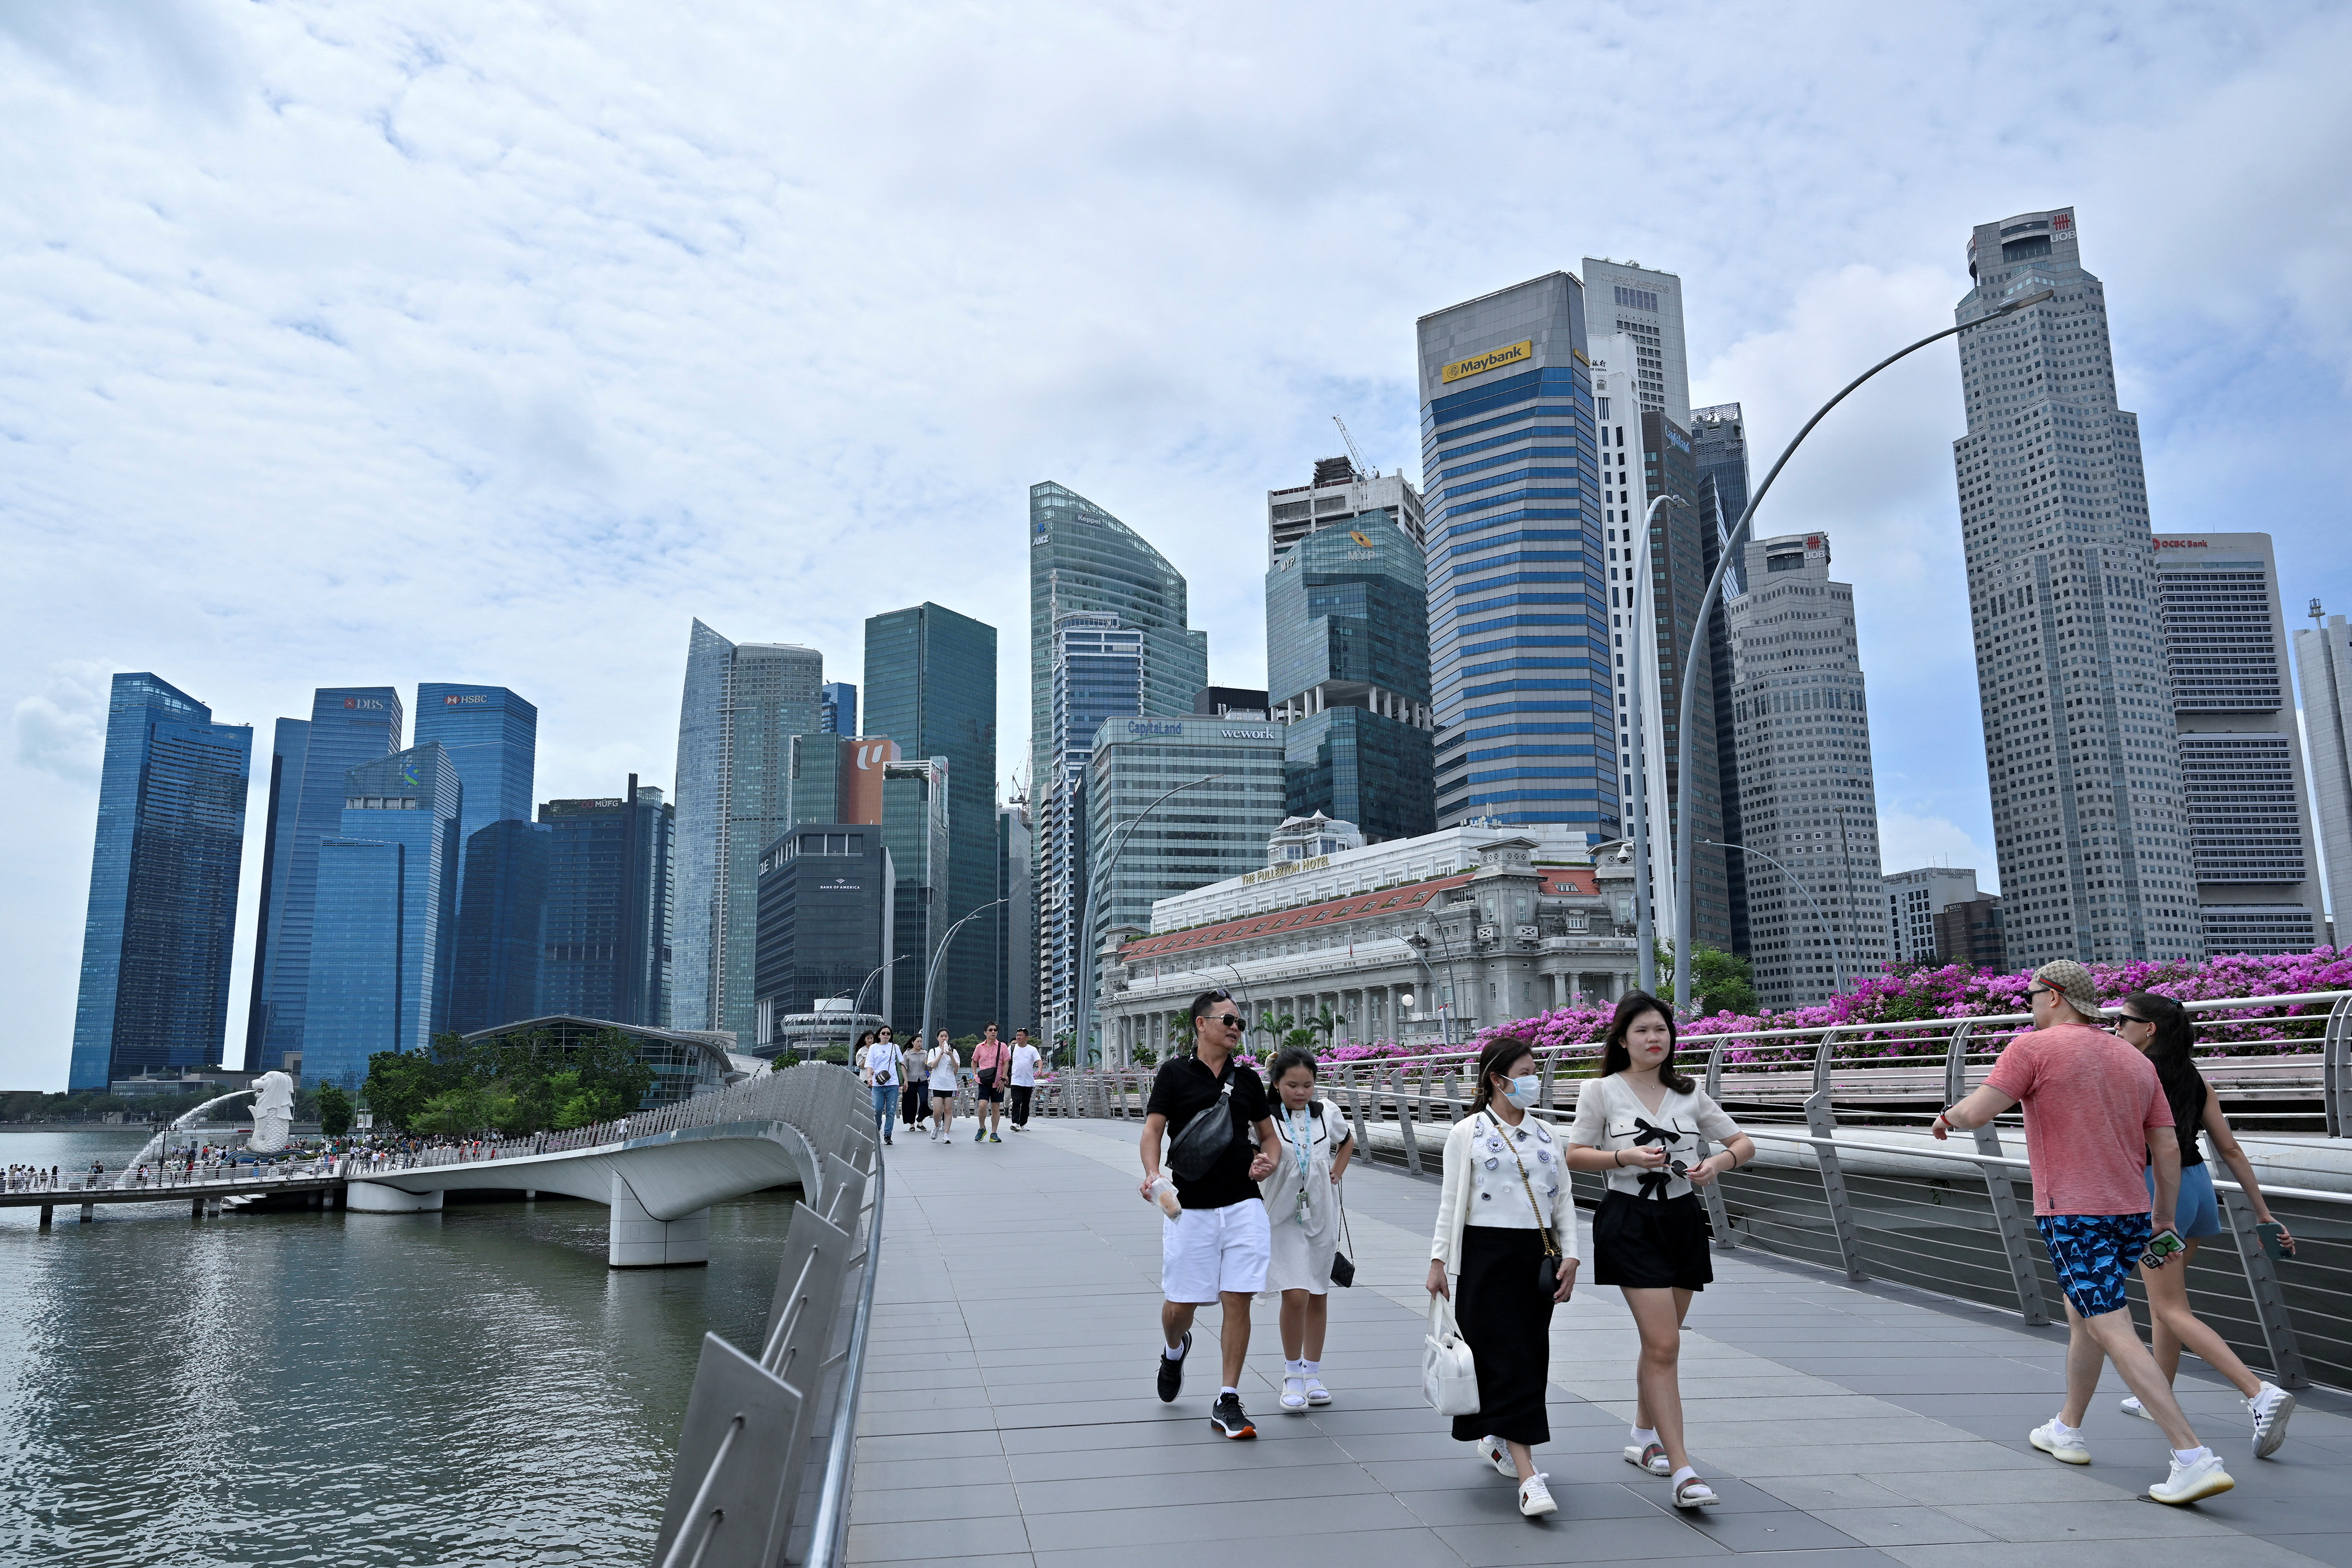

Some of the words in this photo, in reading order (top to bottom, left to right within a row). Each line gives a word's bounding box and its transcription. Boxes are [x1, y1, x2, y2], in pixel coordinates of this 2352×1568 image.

[2050, 230, 2076, 242] UOB
[1460, 346, 1523, 374] Maybank
[1077, 514, 1101, 525] Keppel
[1032, 535, 1050, 547] ANZ
[1348, 550, 1375, 561] MYP
[1804, 550, 1825, 561] UOB
[1281, 556, 1295, 572] MYP
[357, 699, 384, 710] DBS
[461, 695, 488, 703] HSBC
[1128, 720, 1182, 736] CapitaLand
[1221, 727, 1275, 739] wework
[759, 858, 769, 876] OUE
[1241, 874, 1255, 885] THE
[1257, 862, 1300, 882] FULLERTON
[1302, 855, 1329, 871] HOTEL
